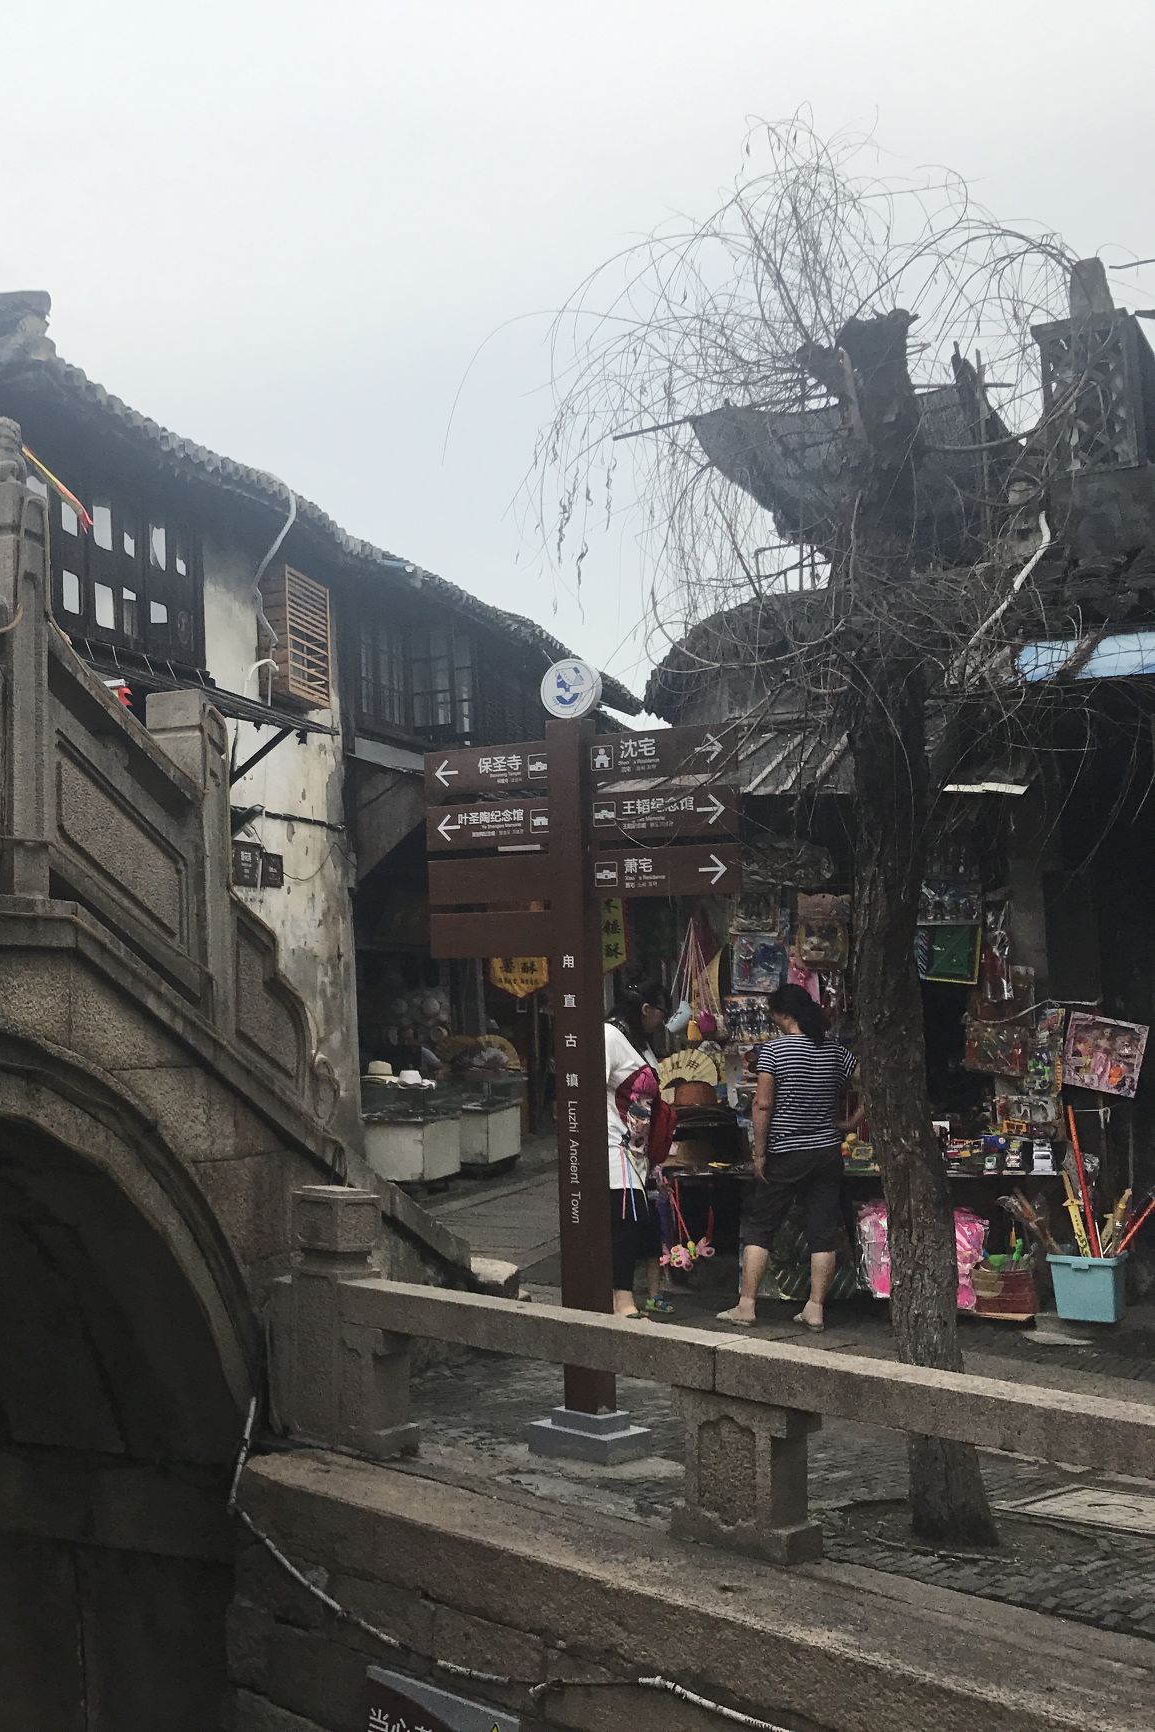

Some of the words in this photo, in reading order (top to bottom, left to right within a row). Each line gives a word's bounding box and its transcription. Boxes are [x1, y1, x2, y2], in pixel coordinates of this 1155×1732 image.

[620, 738, 656, 758] 沈宅
[478, 754, 522, 774] 保圣寺
[458, 808, 524, 825] 叶圣陶纪念馆
[624, 858, 653, 873] 萧宅
[562, 954, 579, 1087] 甪直古镇
[568, 1100, 579, 1133] Luzhi
[569, 1138, 580, 1184] Ancient
[570, 1191, 581, 1223] Town
[367, 1707, 433, 1732] 当心
